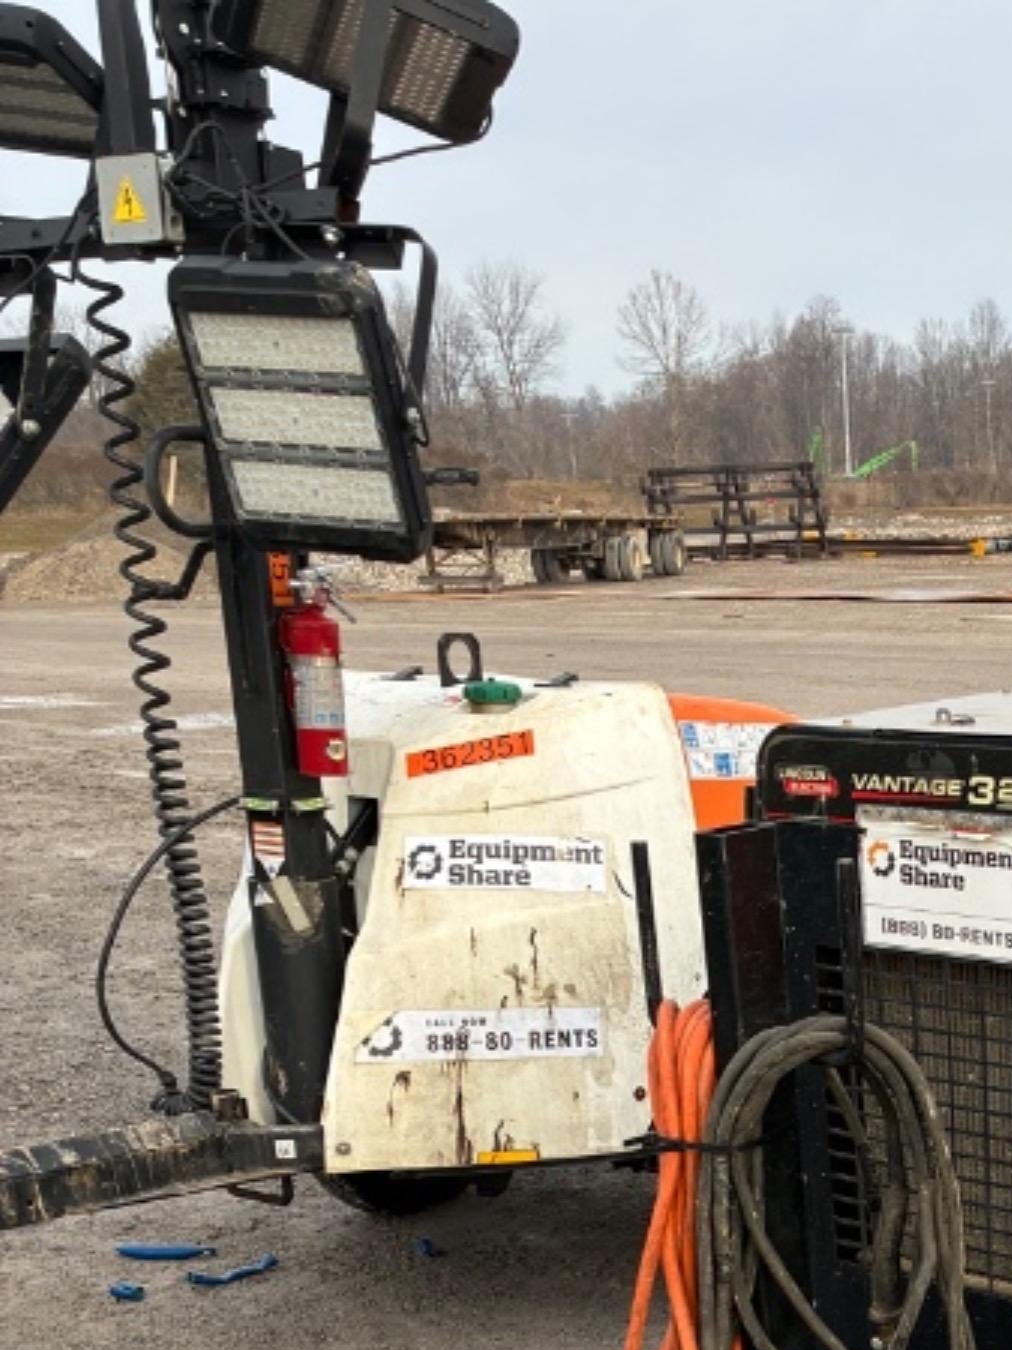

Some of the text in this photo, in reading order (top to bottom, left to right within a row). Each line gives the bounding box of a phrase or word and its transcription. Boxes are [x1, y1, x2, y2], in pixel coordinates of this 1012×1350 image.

[422, 731, 530, 774] 362351
[852, 773, 964, 797] VANTAGE
[449, 838, 604, 865] Equipment
[449, 863, 532, 887] Share
[899, 863, 965, 892] Share
